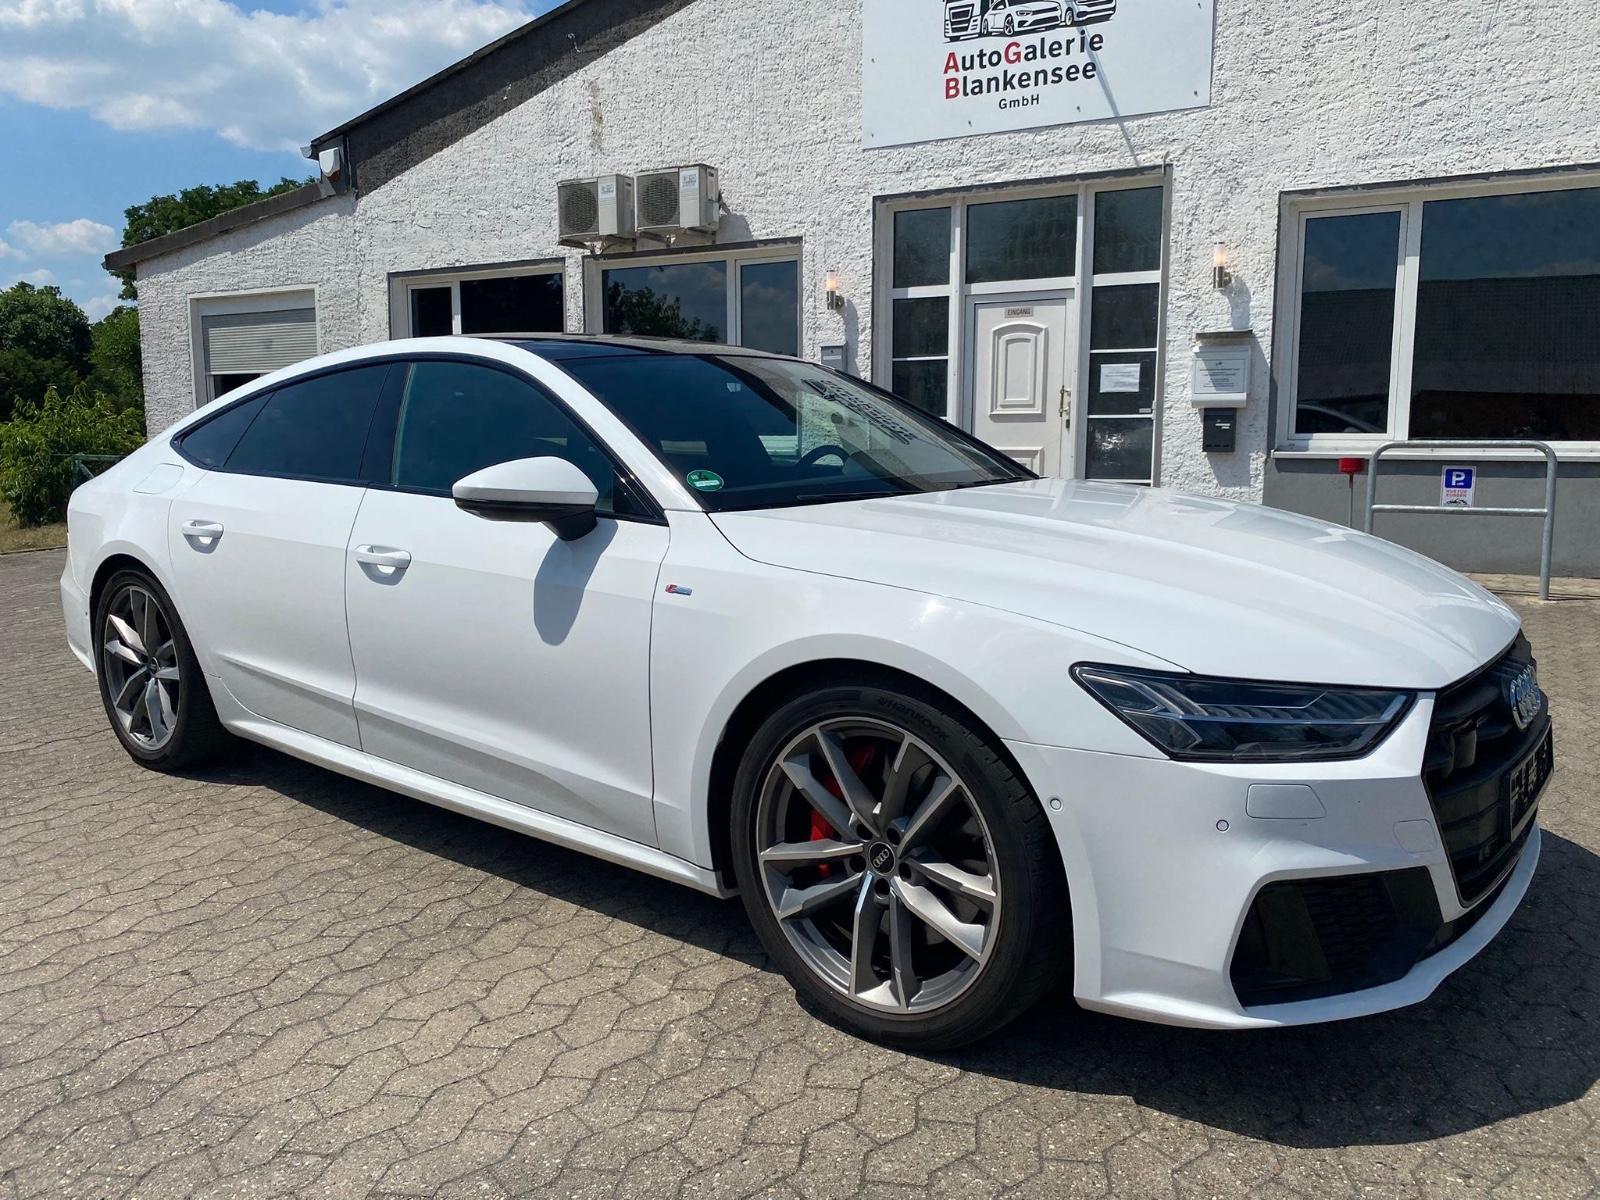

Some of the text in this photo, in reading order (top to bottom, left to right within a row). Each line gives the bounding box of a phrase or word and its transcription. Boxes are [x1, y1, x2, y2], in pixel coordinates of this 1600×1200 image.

[943, 29, 1104, 75] AutoGalerie
[944, 60, 1097, 99] Blankensee
[998, 94, 1040, 110] GmbH
[1451, 471, 1465, 485] P
